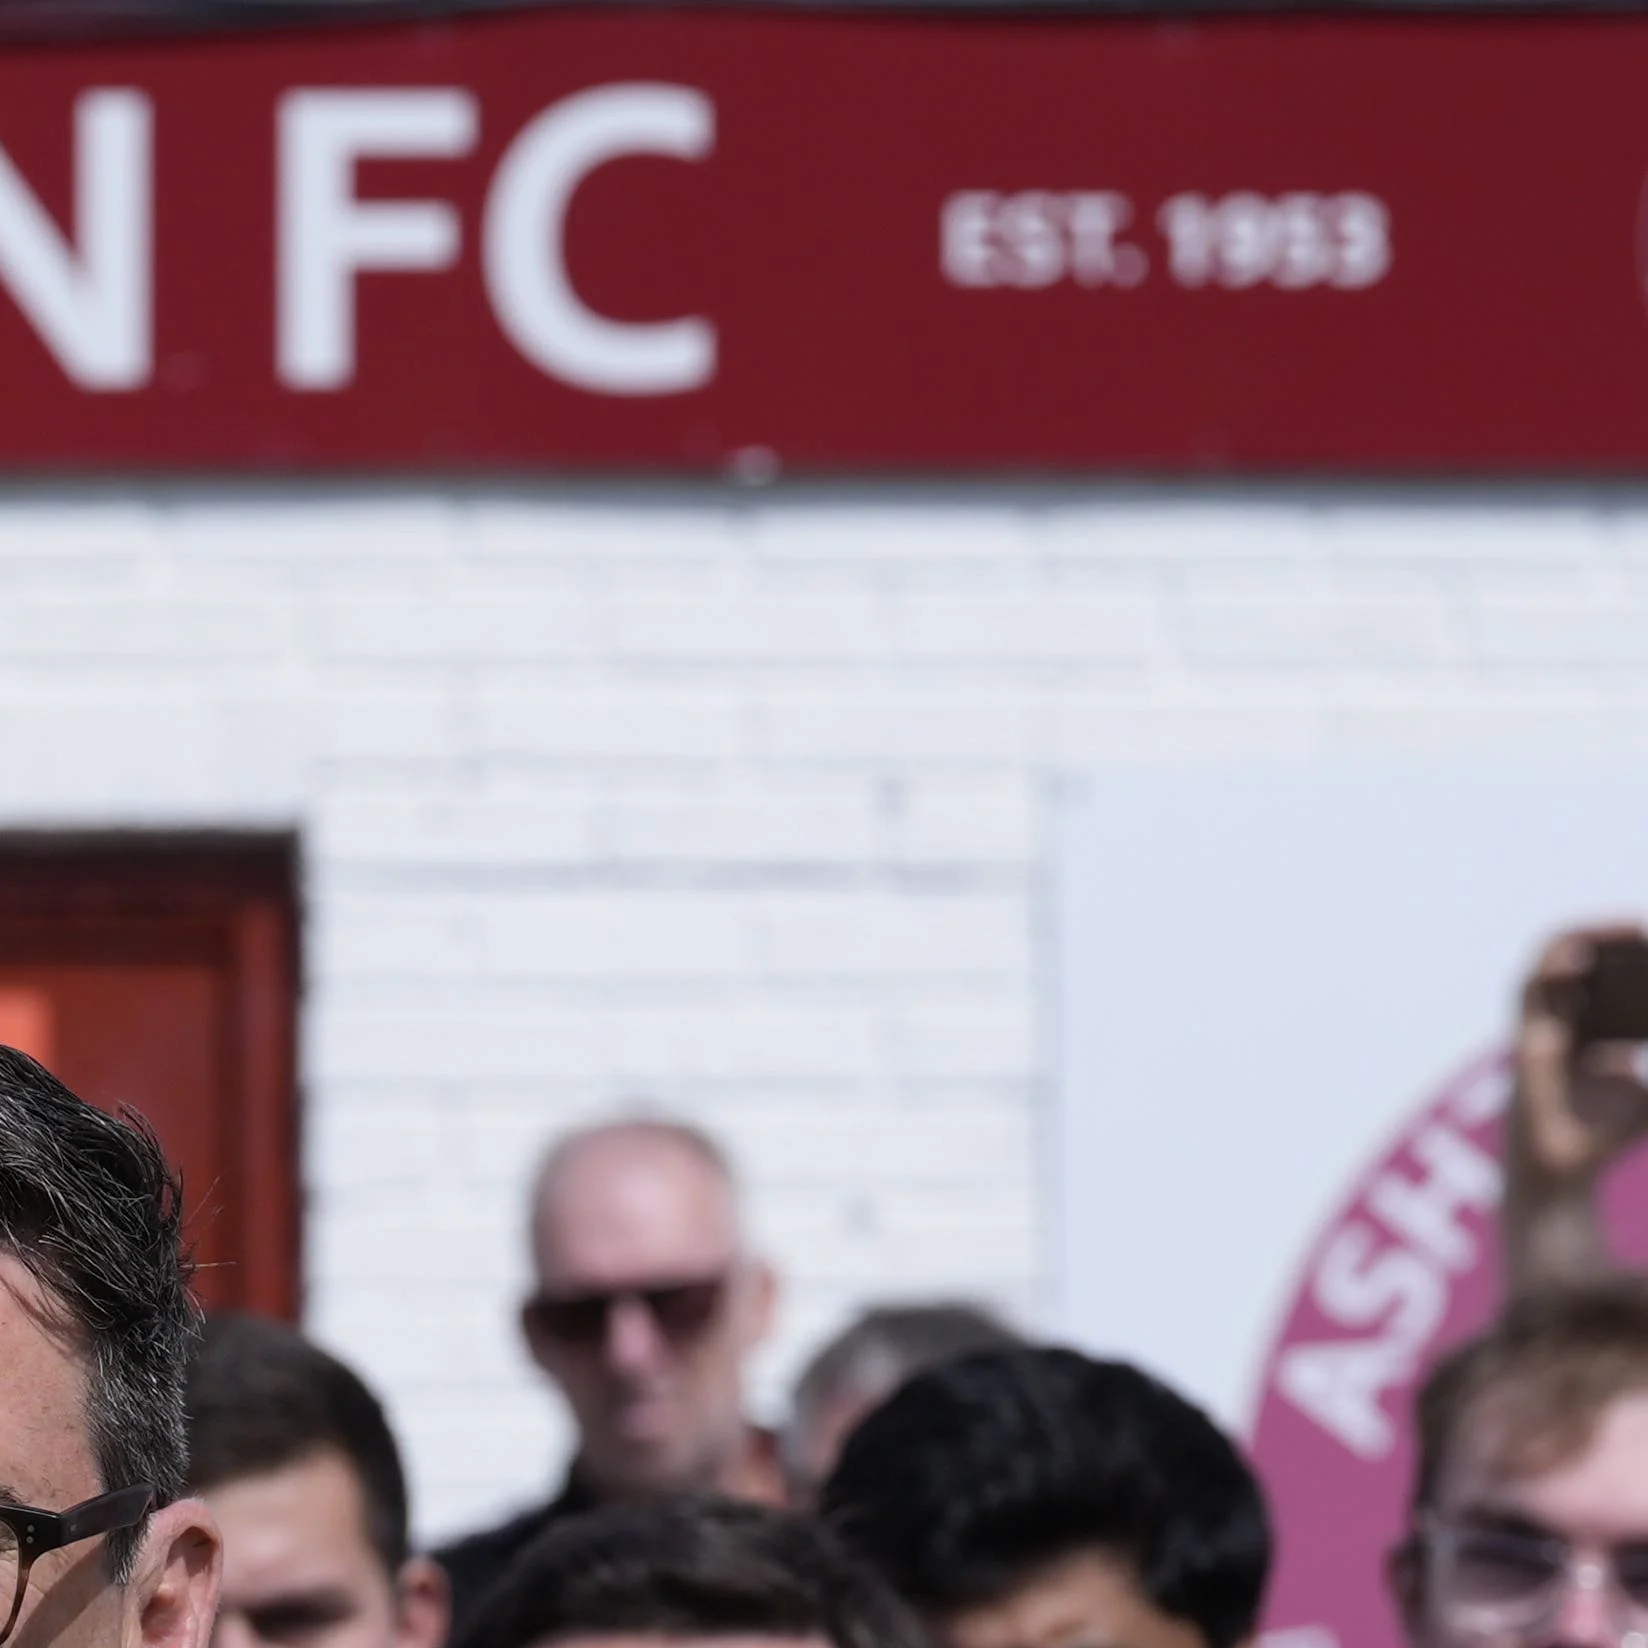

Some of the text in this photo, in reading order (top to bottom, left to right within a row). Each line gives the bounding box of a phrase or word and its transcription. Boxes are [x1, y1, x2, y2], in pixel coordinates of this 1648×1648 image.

[276, 83, 715, 394] FC
[942, 193, 1388, 286] EST. 1953
